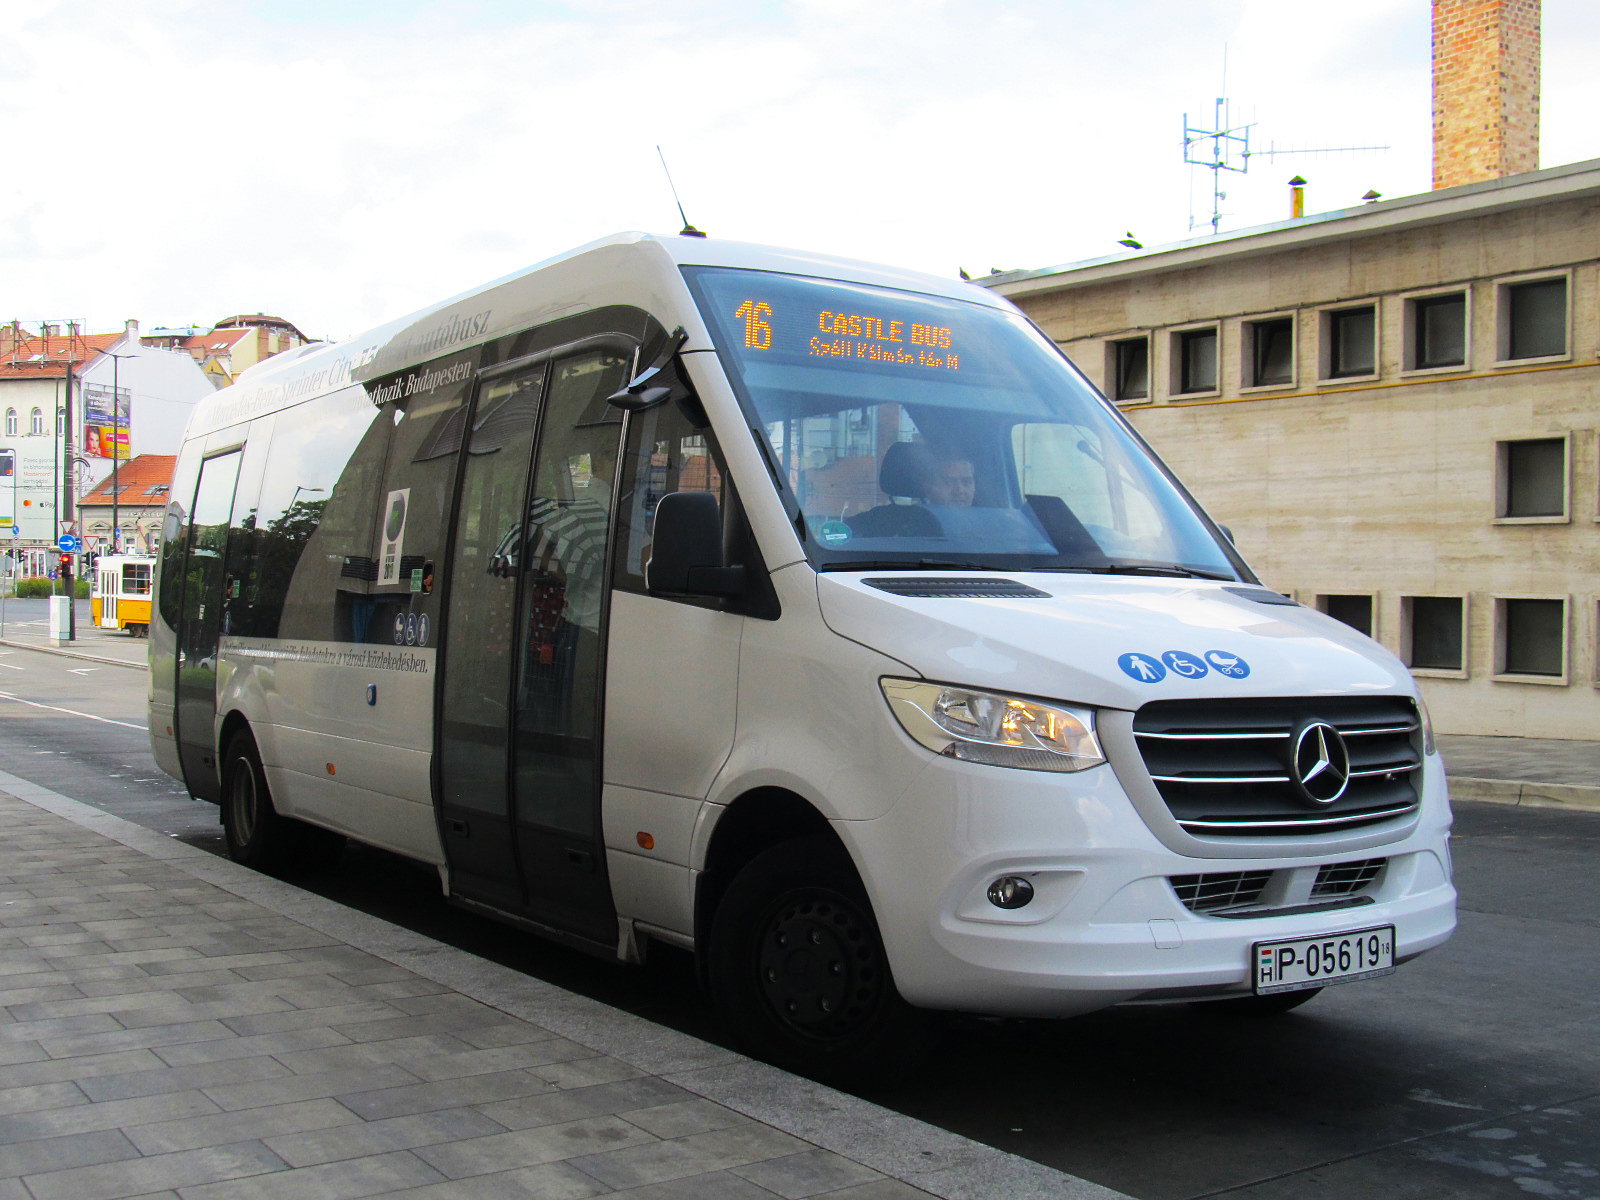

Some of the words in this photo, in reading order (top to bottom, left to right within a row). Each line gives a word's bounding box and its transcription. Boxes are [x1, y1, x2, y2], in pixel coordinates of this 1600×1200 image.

[735, 299, 773, 351] 16
[819, 310, 905, 343] CASTLE
[911, 323, 952, 349] BUS
[404, 360, 472, 396] Budapesten
[946, 353, 960, 370] M
[365, 651, 428, 674] közlekedésben.
[1261, 967, 1273, 983] H
[1278, 934, 1380, 981] P-05619
[1381, 942, 1390, 955] 18
